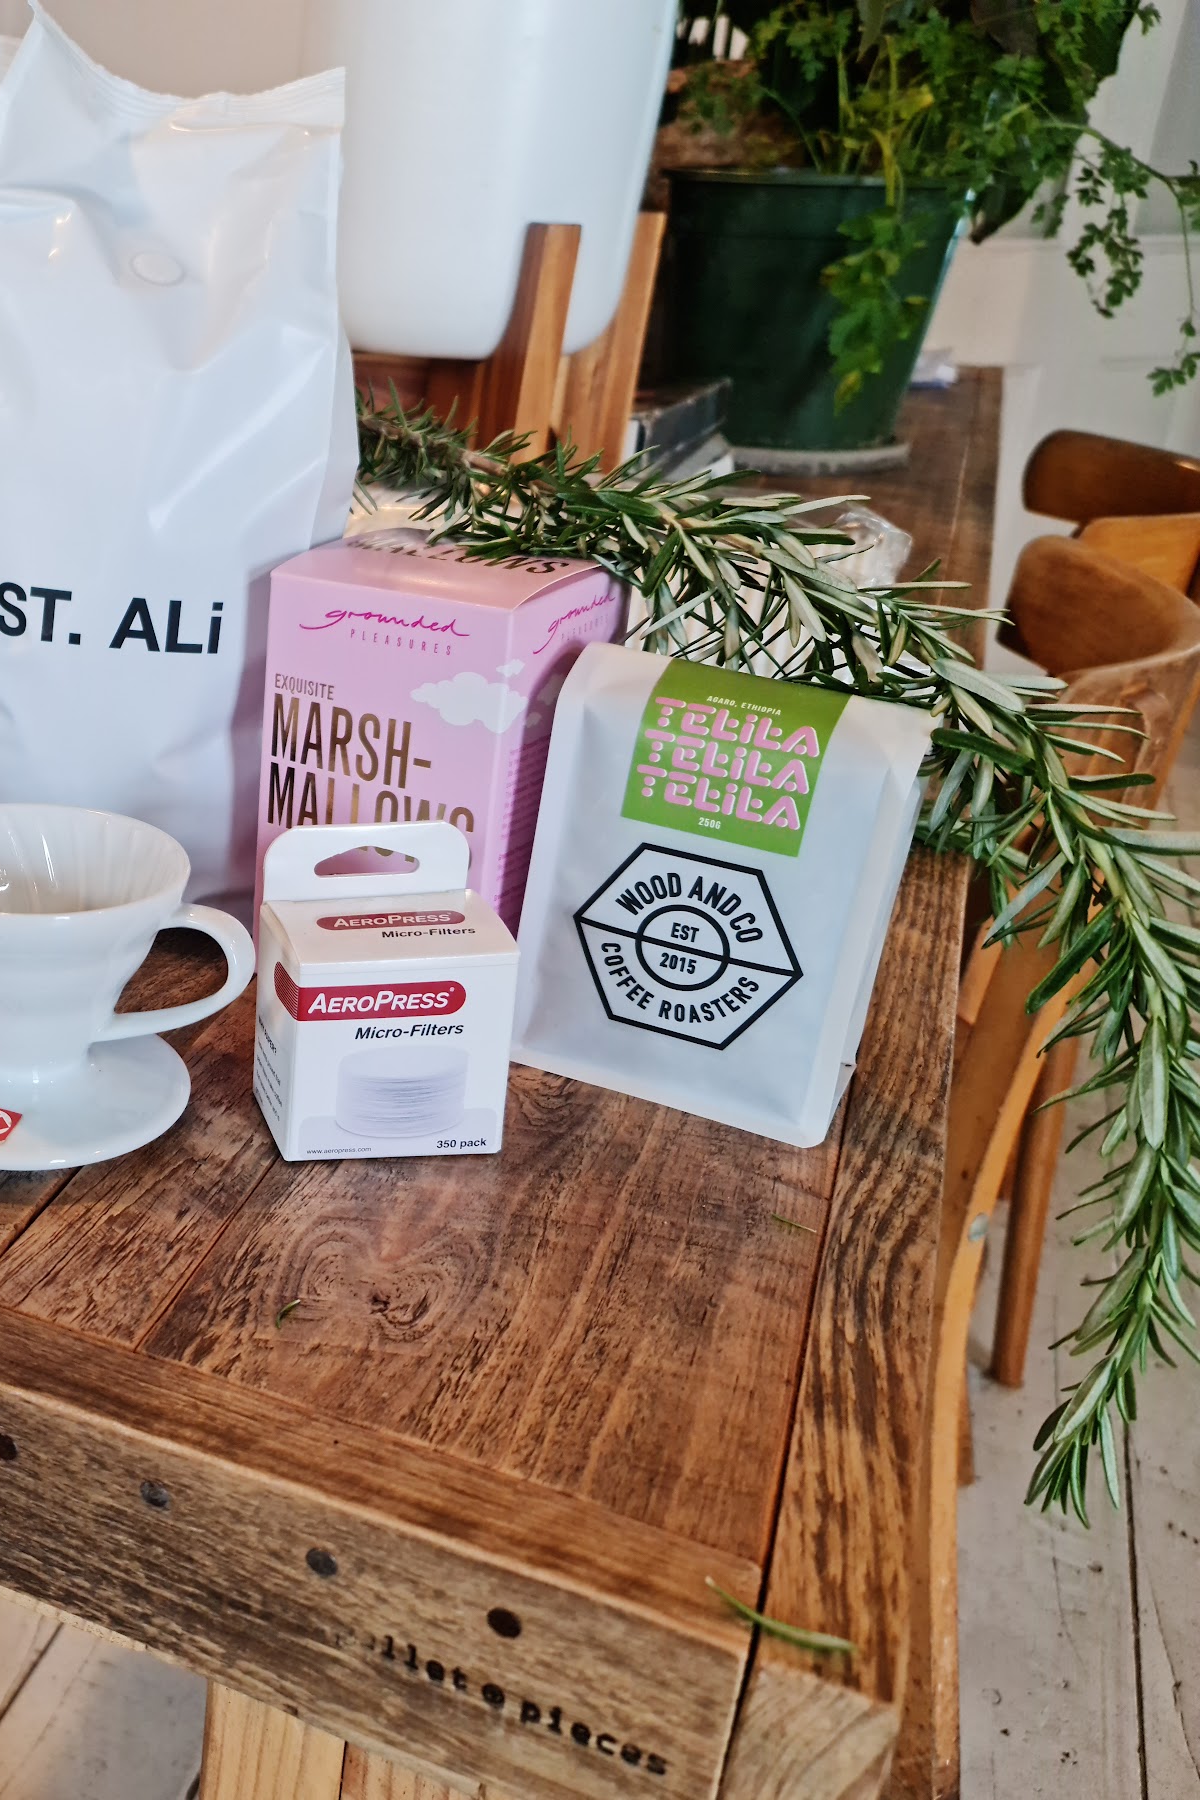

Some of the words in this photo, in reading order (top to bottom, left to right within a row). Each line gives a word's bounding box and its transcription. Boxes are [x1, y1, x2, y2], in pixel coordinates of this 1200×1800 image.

[299, 608, 470, 637] grounded
[533, 592, 616, 654] grounded
[350, 628, 452, 656] PLEASURES
[274, 672, 335, 701] EXQUISITE
[741, 702, 781, 715] ETHIOPIA
[270, 692, 432, 789] MARSH-
[615, 872, 682, 917] WOOD
[687, 876, 742, 918] AND
[728, 912, 764, 943] CO
[382, 927, 476, 938] Micro-Filters
[670, 922, 700, 943] EST
[659, 953, 697, 975] 2015
[600, 942, 655, 1010] COFFEE
[657, 976, 760, 1024] ROASTERS
[355, 1023, 464, 1040] Micro-Filters
[306, 1146, 372, 1155] www.aeropress.com
[437, 1138, 458, 1149] 350
[460, 1138, 487, 1151] pack
